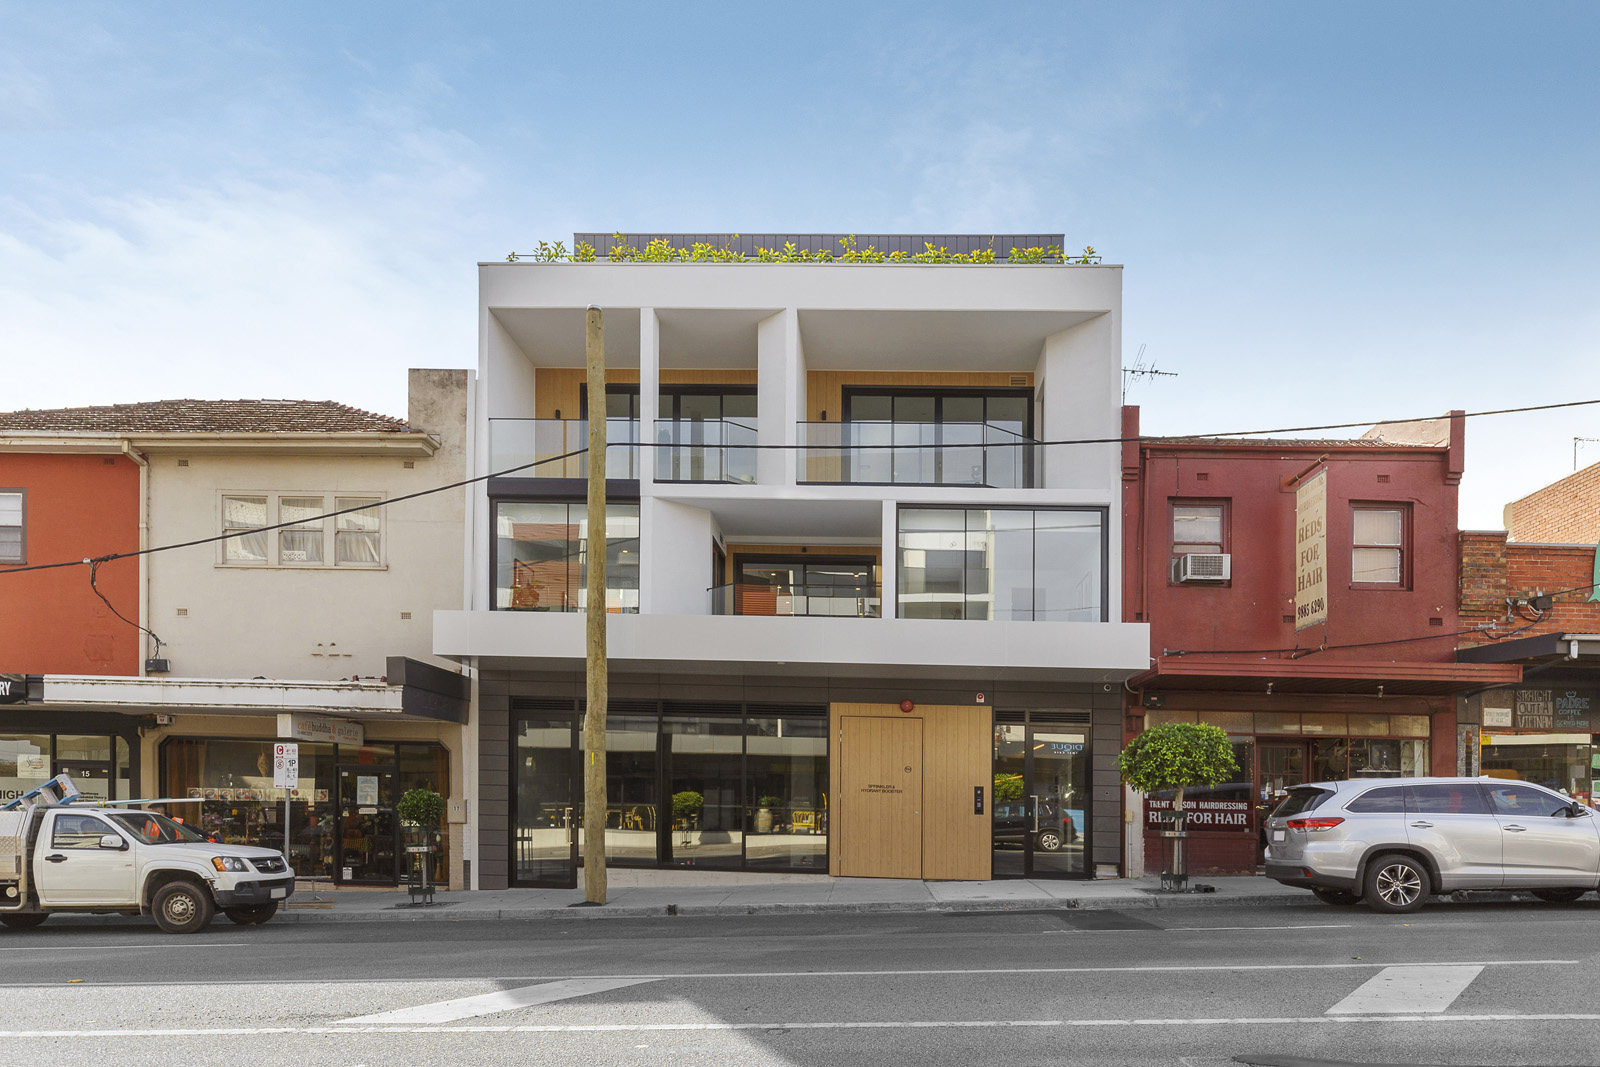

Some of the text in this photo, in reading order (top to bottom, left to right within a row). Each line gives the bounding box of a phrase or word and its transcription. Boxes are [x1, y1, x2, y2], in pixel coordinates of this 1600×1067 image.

[1298, 515, 1323, 544] REDS
[1300, 543, 1321, 567] FOR
[1297, 566, 1323, 592] HAIR
[1297, 596, 1325, 620] 9885 6290
[1516, 690, 1553, 702] STRAIGHT
[1555, 697, 1590, 709] PADRE
[1517, 715, 1554, 729] VIETNAM
[337, 725, 359, 737] galerie
[288, 759, 296, 767] 1P
[81, 770, 90, 778] 15
[1148, 800, 1170, 809] TRENT
[1199, 801, 1248, 810] HAIRDRESSING
[1186, 812, 1213, 824] FOR
[1214, 812, 1247, 825] HAIR
